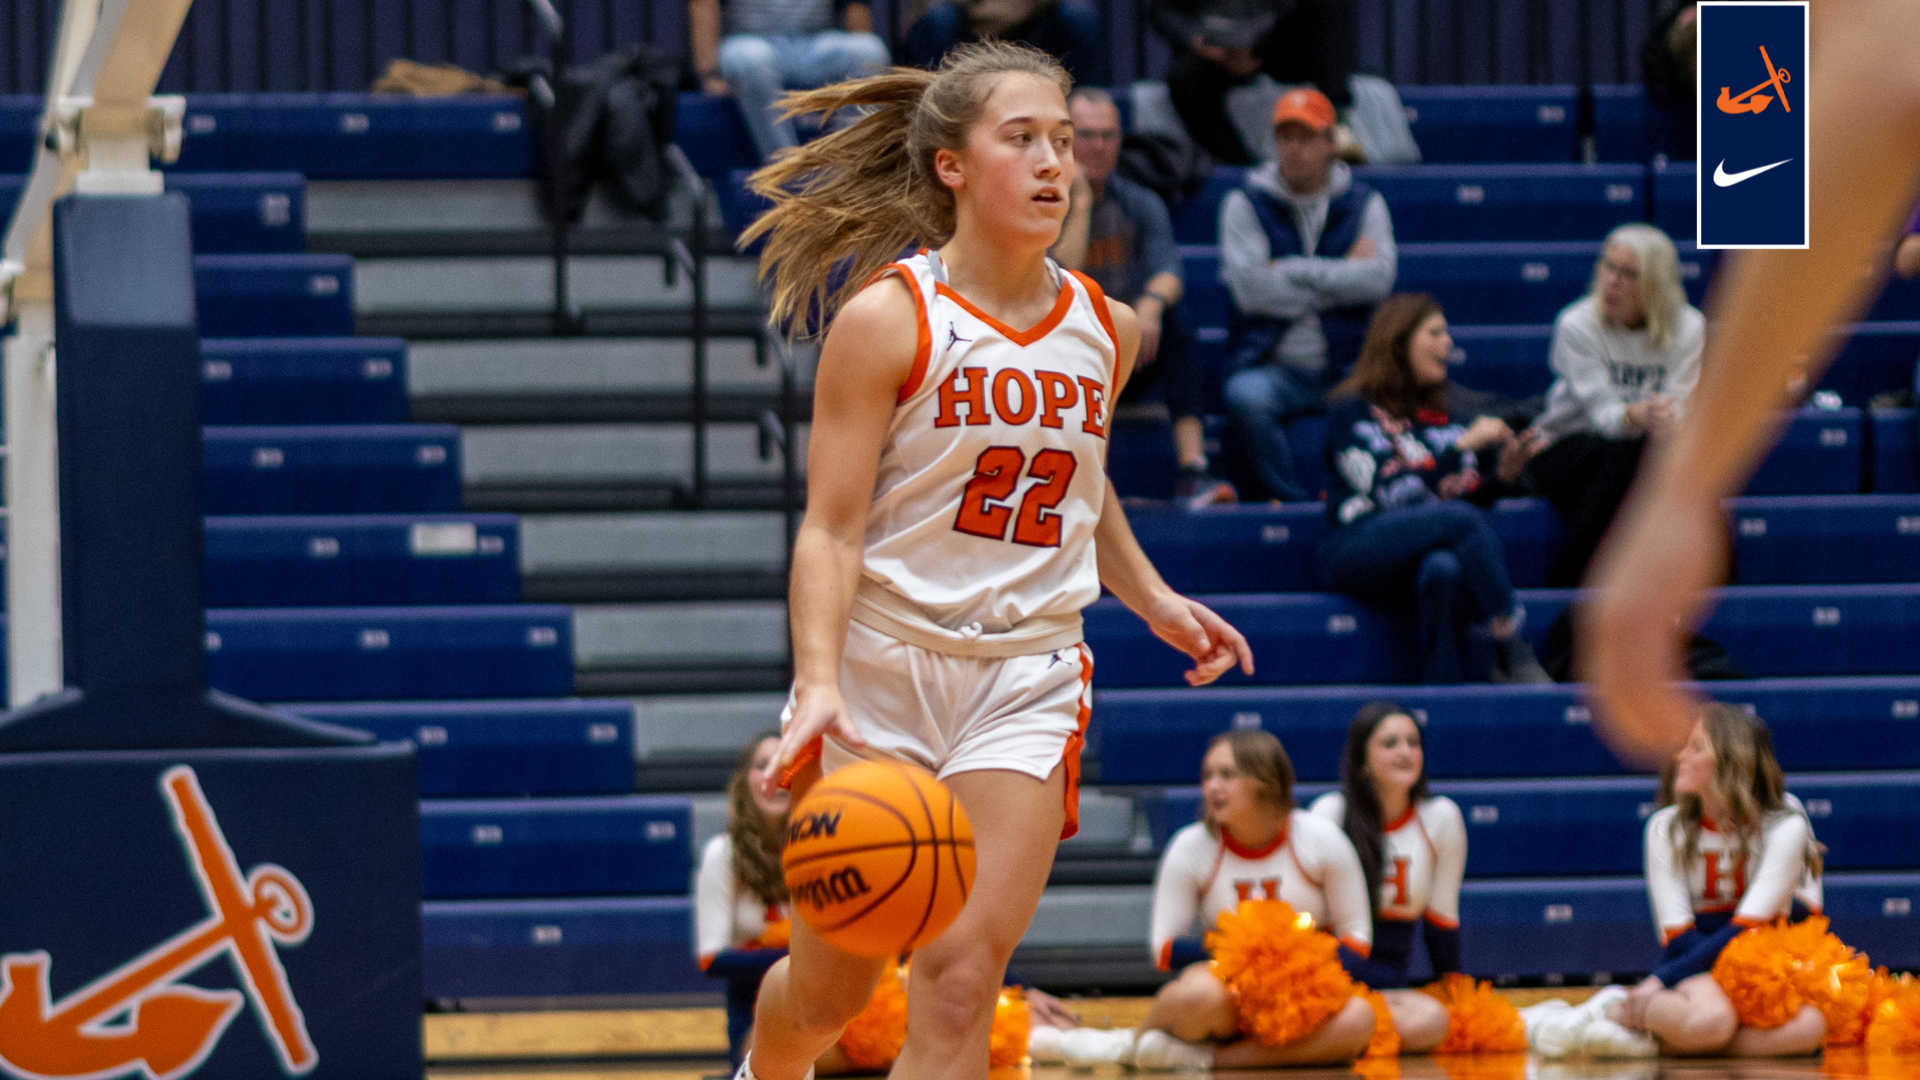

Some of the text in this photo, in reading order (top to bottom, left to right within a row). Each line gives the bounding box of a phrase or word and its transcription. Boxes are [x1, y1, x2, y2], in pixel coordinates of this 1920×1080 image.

[934, 367, 1106, 440] HOPE
[952, 445, 1077, 548] 22
[1703, 851, 1749, 901] H
